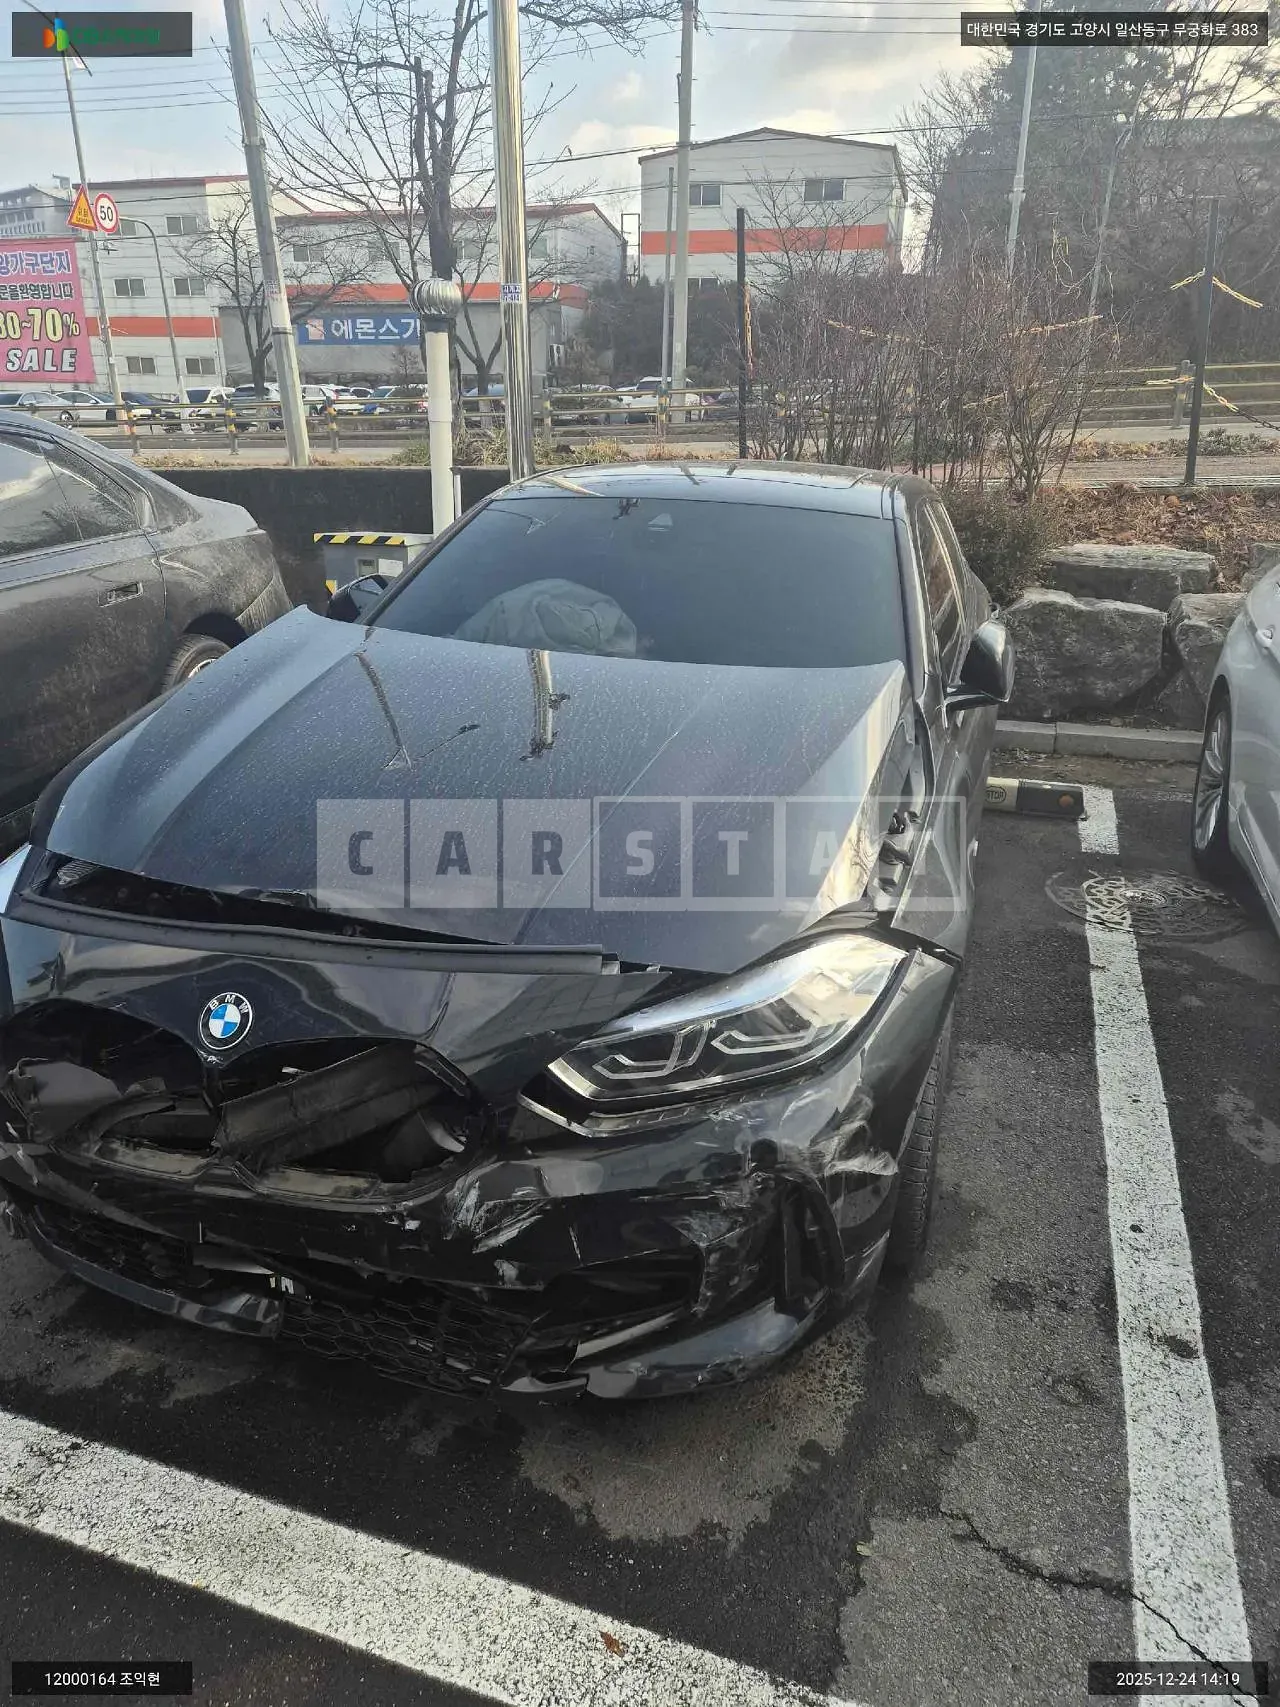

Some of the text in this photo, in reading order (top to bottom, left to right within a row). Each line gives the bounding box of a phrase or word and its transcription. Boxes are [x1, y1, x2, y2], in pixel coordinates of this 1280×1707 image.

[100, 205, 114, 222] 50
[6, 347, 77, 372] SALE
[209, 994, 249, 1014] BMW
